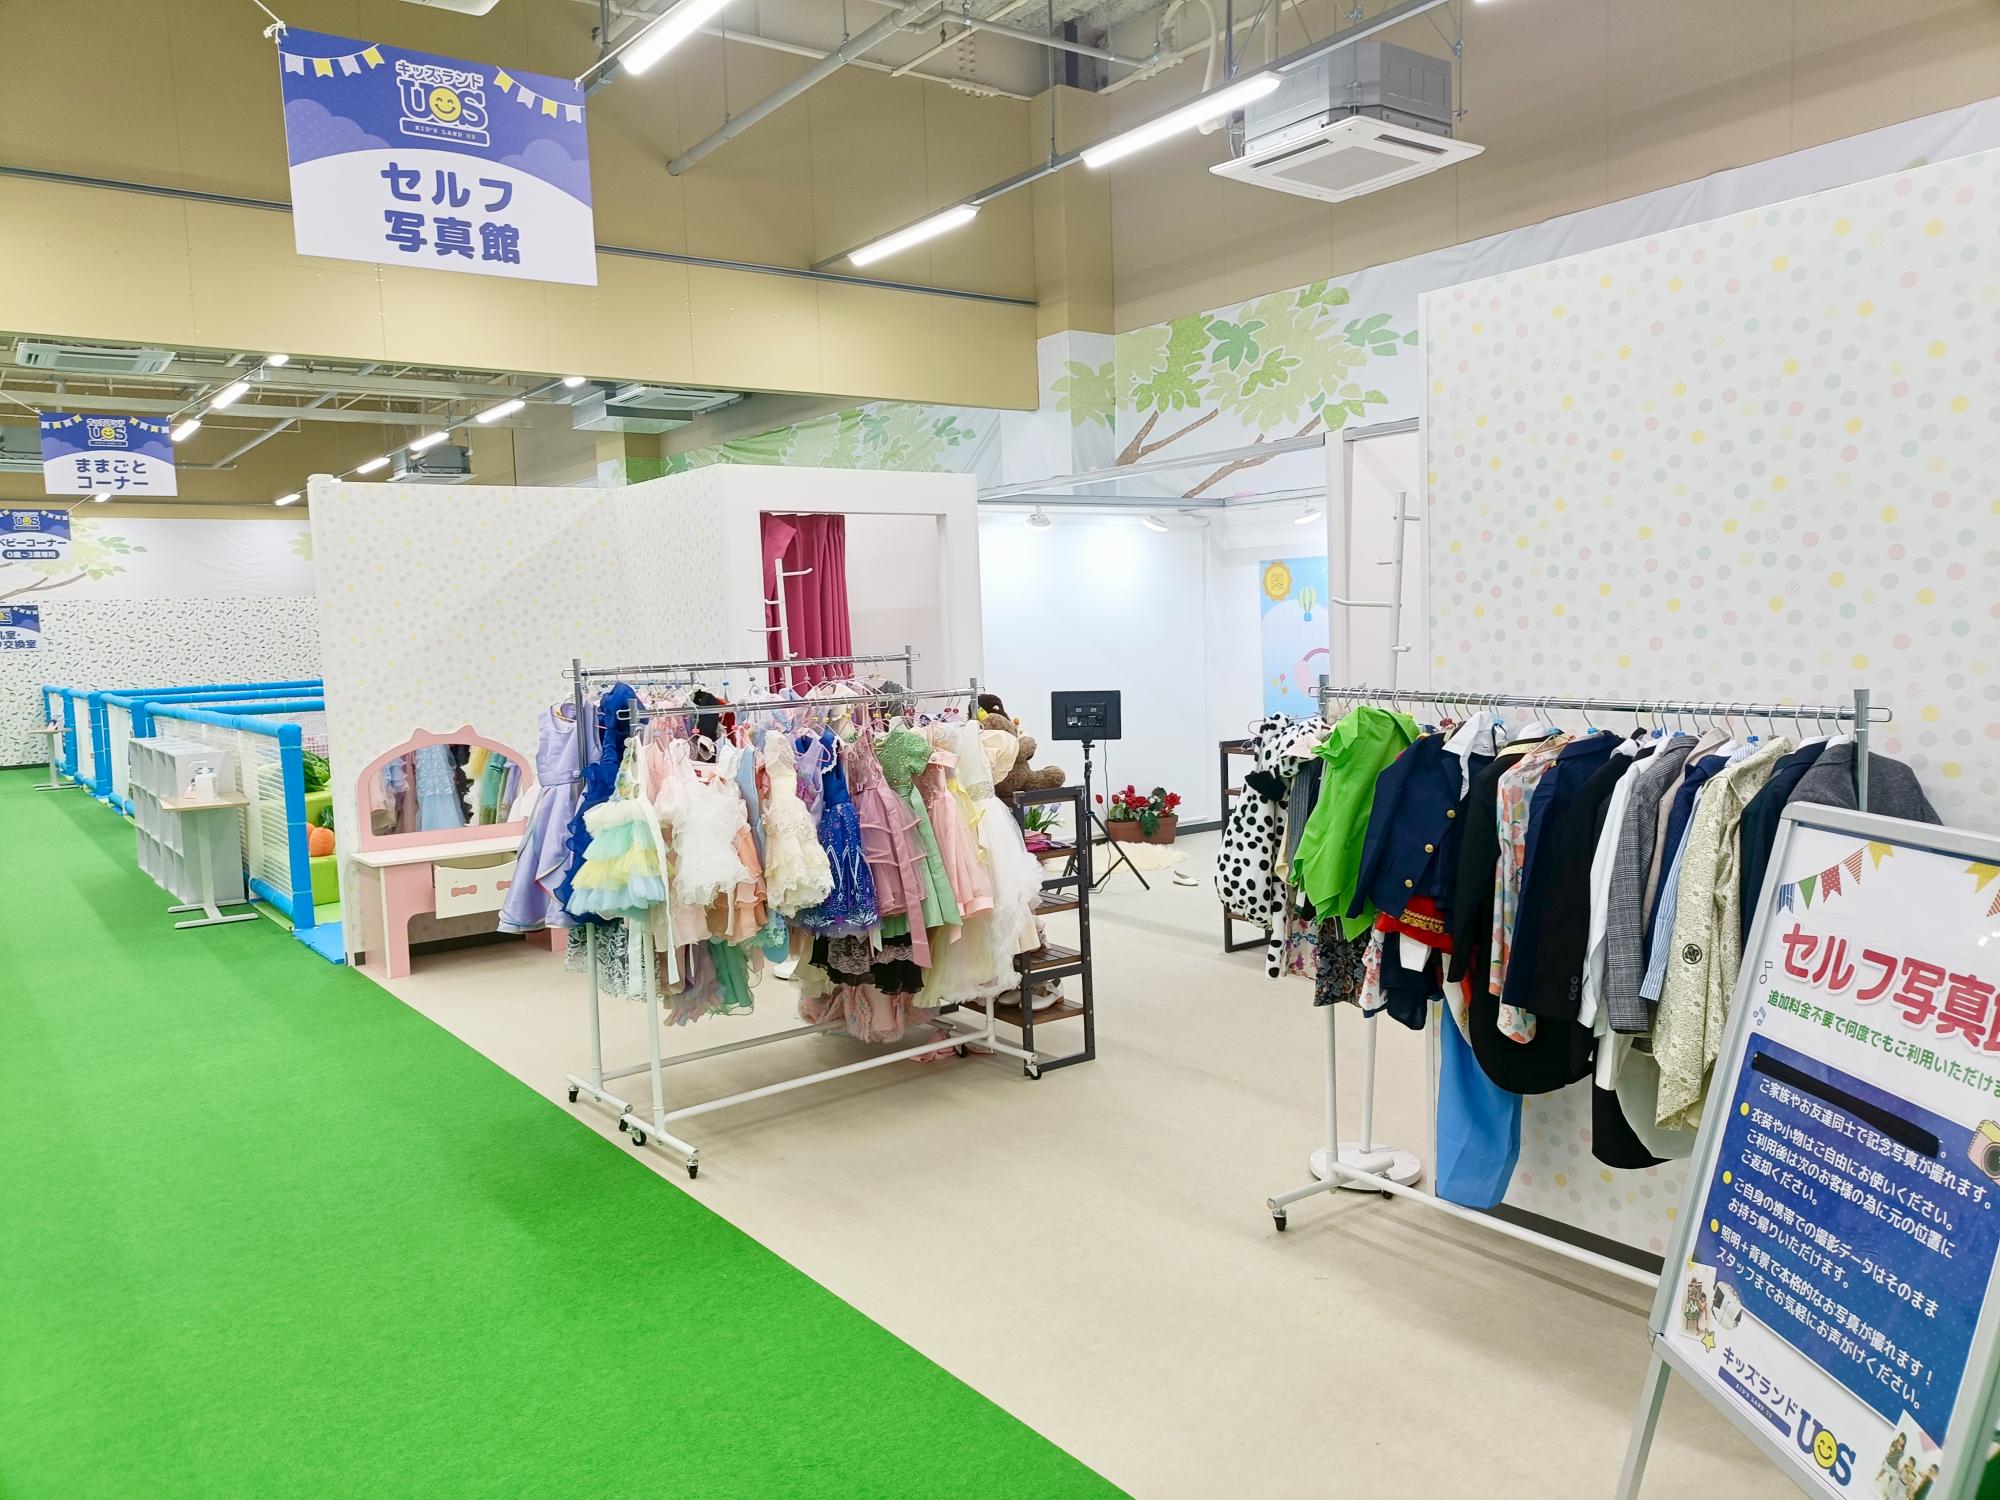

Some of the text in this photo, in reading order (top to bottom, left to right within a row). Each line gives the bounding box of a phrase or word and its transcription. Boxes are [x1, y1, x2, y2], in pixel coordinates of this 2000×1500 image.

[396, 60, 484, 89] キッズランド
[380, 161, 513, 213] セルフ
[384, 209, 521, 265] 写真館
[75, 458, 147, 474] ままごと
[78, 476, 149, 489] コーナー
[1741, 1148, 1818, 1206] ご返却ください。
[1751, 1107, 1953, 1231] 衣装や小物はご自由にお使いください。
[1759, 1078, 1991, 1210] ご家族やお友達同士で記念写真が撮れます。
[1746, 1128, 1956, 1259] ご利用後は次のお客様の為に元の位置に
[1728, 1197, 1849, 1289] お持ち帰りいただけます。
[1734, 1177, 1939, 1319] ご自身の携帯での撮影データはそのまま
[1716, 1246, 1920, 1410] スタッフまでお気軽にお声がけください。
[1722, 1346, 1798, 1416] キッズランド
